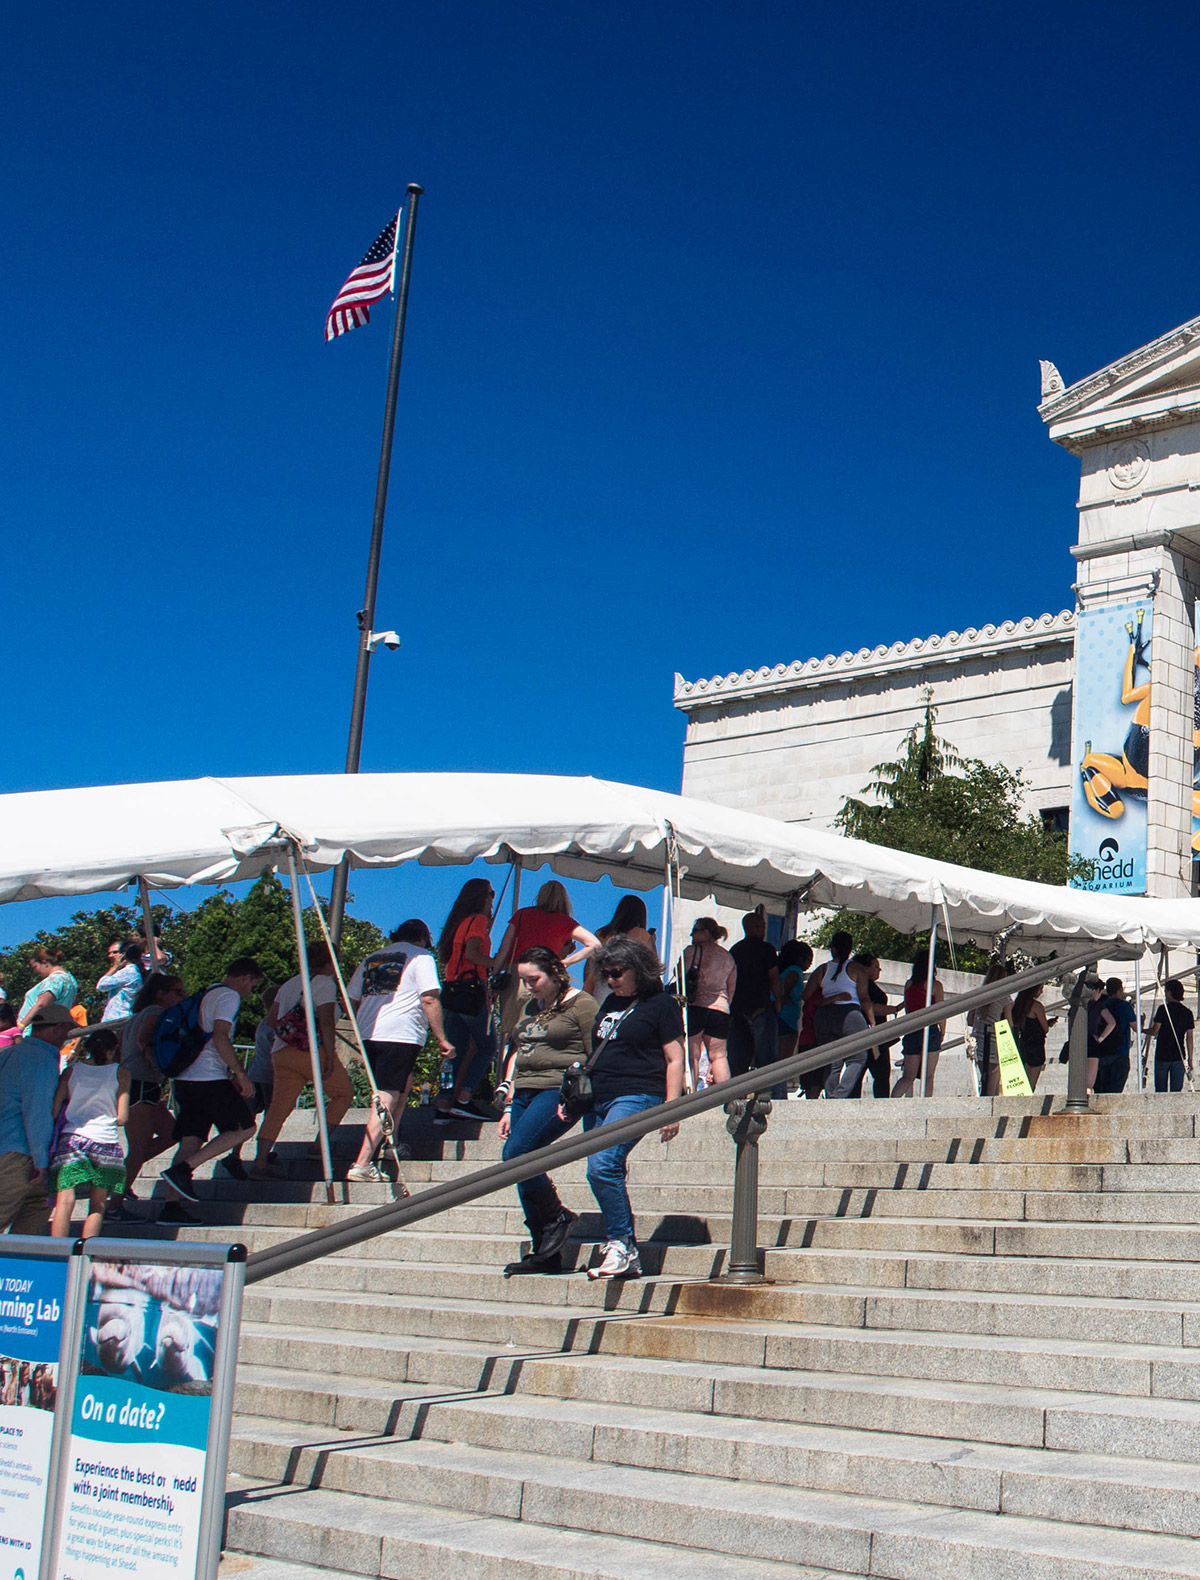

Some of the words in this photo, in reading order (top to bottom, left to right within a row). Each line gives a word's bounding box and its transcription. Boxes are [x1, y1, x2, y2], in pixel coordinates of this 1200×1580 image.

[1084, 857, 1134, 881] hedd
[1006, 1081, 1025, 1090] FLOOR
[5, 1278, 33, 1293] TODAY
[0, 1295, 35, 1326] rning
[37, 1298, 60, 1322] Lab
[81, 1393, 104, 1421] On
[105, 1403, 117, 1424] a
[118, 1397, 165, 1430] date?
[75, 1457, 120, 1478] Experience
[120, 1465, 135, 1482] the
[136, 1467, 155, 1486] best
[73, 1480, 91, 1497] with
[92, 1485, 99, 1498] a
[97, 1483, 119, 1502] joint
[70, 1502, 91, 1515] Benefits
[92, 1507, 111, 1520] include
[111, 1511, 144, 1526] year-round
[144, 1519, 166, 1530] express
[76, 1520, 86, 1531] you
[87, 1522, 97, 1532] and
[120, 1528, 132, 1539] plus
[133, 1531, 153, 1543] special
[65, 1546, 81, 1560] things
[81, 1551, 111, 1569] happening
[111, 1558, 118, 1567] at
[70, 1534, 85, 1545] great
[86, 1537, 97, 1549] way
[97, 1539, 104, 1549] to
[104, 1540, 111, 1549] be
[112, 1543, 125, 1554] part
[125, 1544, 132, 1554] of
[132, 1546, 140, 1556] all
[141, 1548, 151, 1558] the
[152, 1551, 179, 1568] amazing
